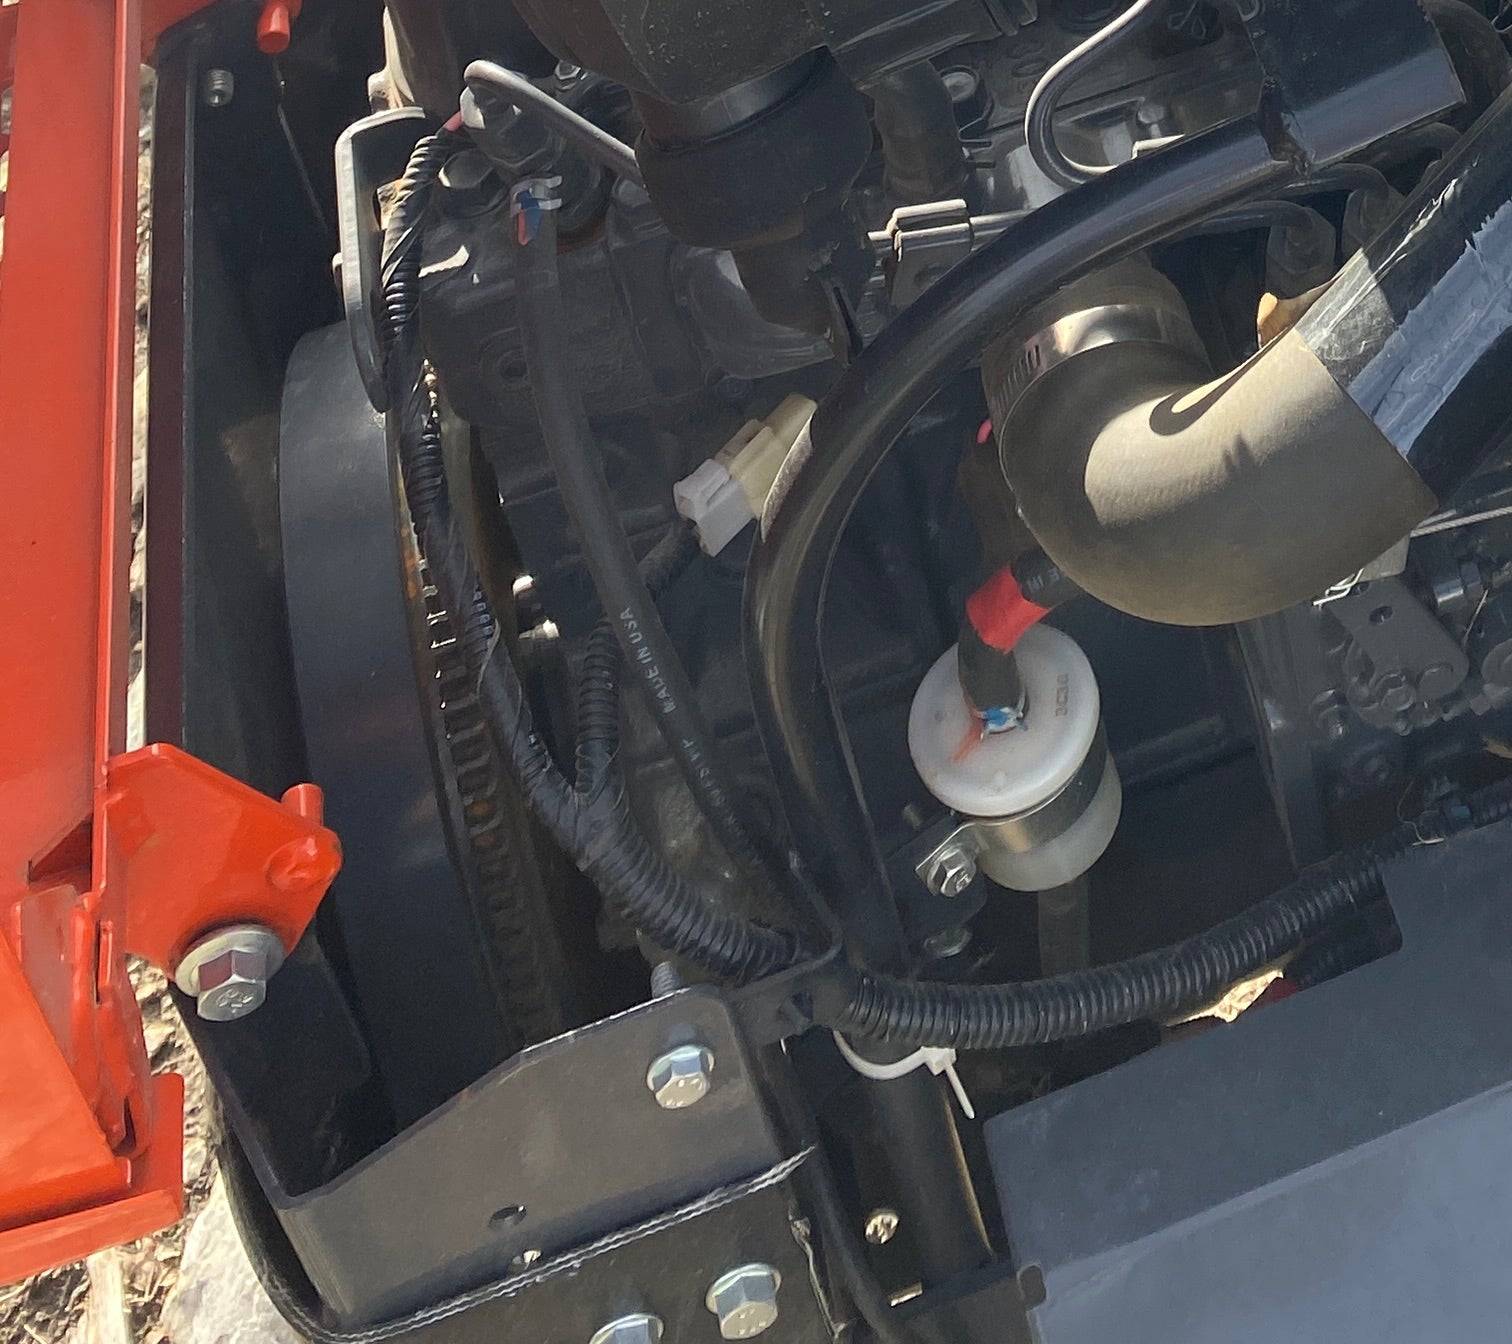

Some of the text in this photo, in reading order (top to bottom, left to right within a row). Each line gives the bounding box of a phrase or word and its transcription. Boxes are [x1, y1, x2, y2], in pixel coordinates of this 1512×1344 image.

[619, 607, 677, 714] MADE IN USA
